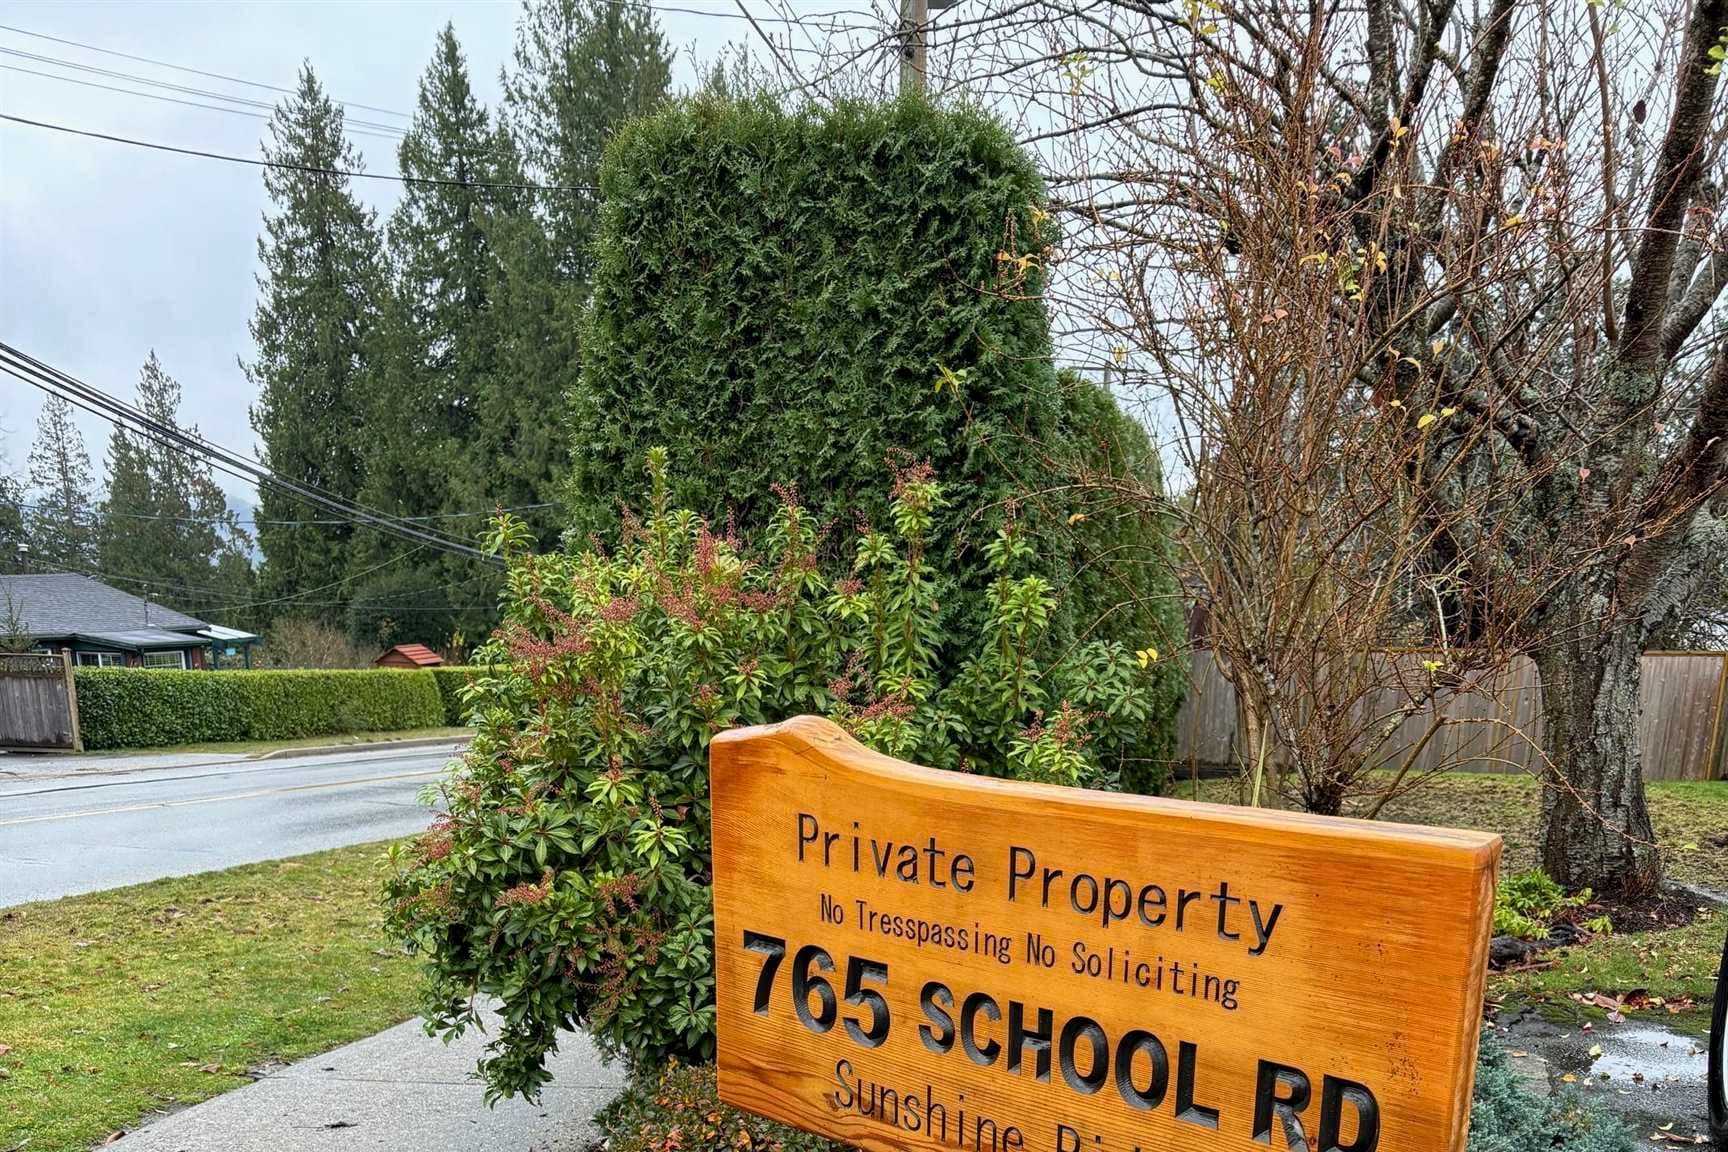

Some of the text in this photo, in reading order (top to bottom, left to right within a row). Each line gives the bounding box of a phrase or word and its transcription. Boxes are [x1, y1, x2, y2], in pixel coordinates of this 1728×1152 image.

[797, 812, 1286, 956] Private Property
[820, 892, 1241, 1009] No Tresspassing No Soliciting
[742, 930, 891, 1048] 765
[919, 981, 1221, 1131] SCHOOL
